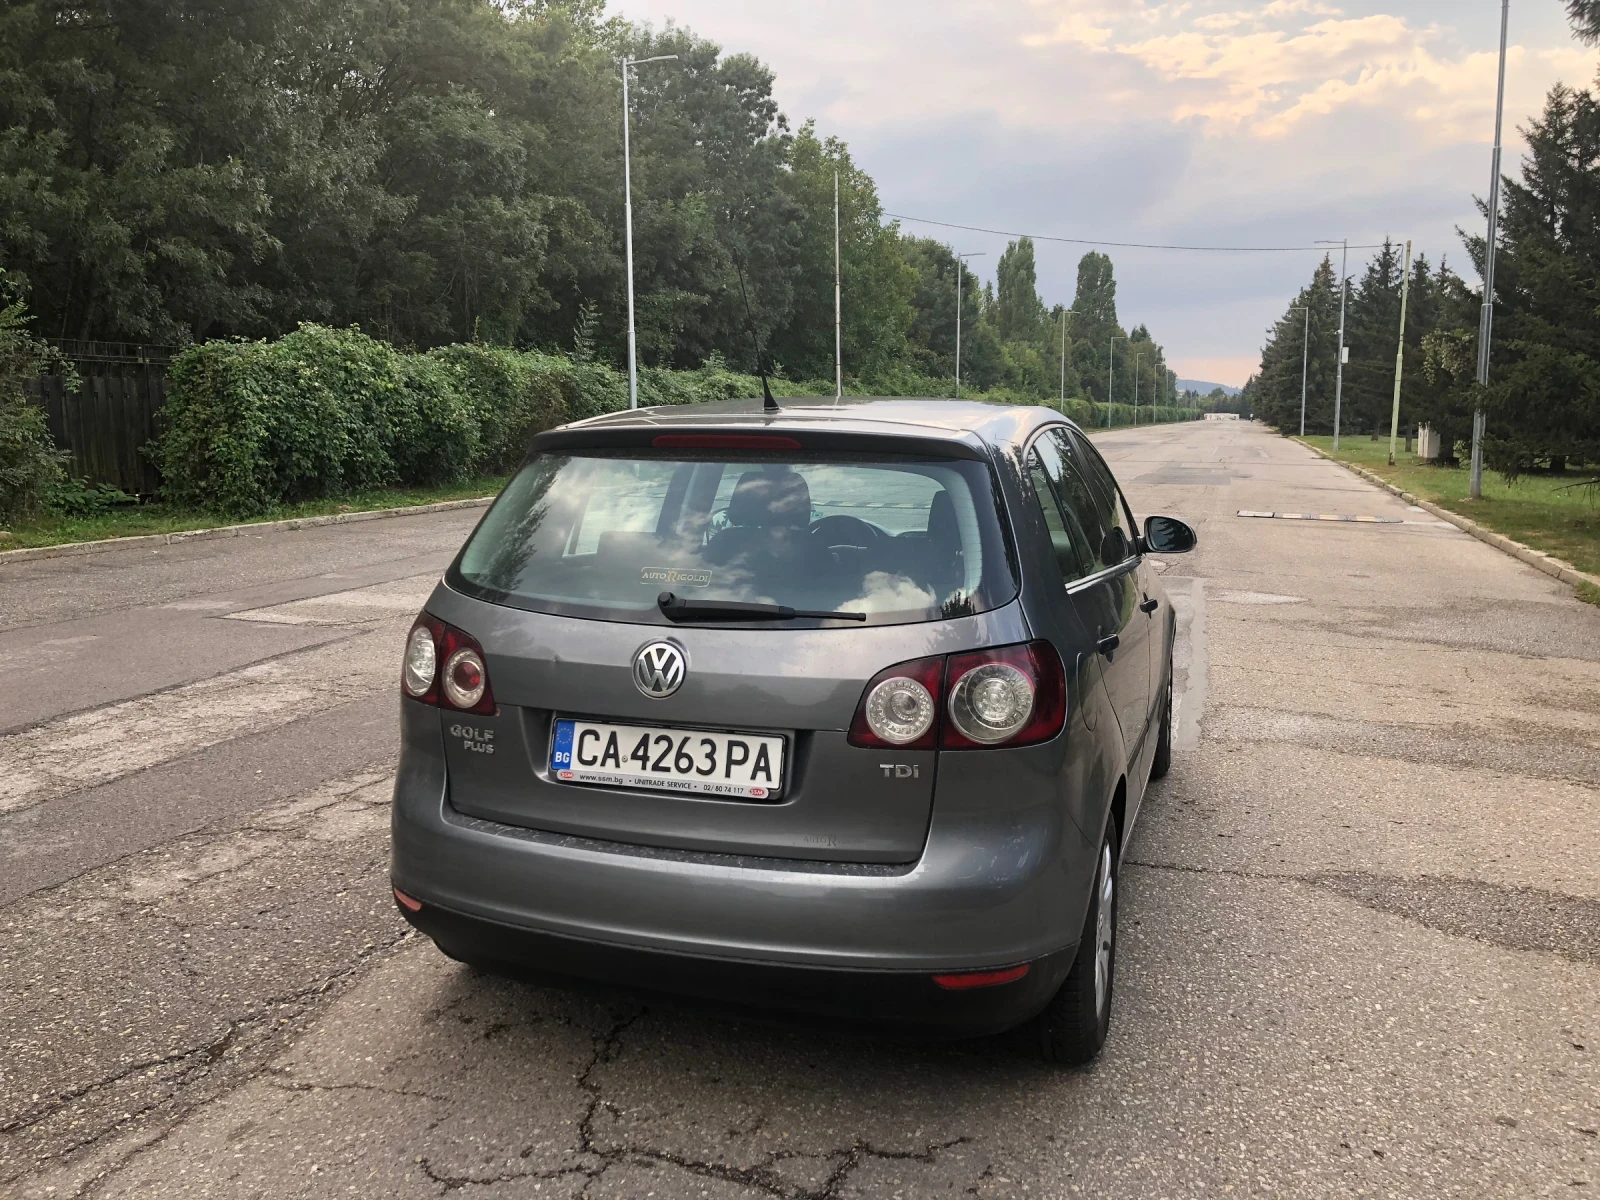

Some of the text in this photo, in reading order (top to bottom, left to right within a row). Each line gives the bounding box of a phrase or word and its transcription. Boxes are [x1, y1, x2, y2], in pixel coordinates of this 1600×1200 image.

[450, 724, 495, 742] GOLF
[463, 740, 495, 754] PLUS
[555, 751, 571, 763] BG
[577, 729, 772, 782] CA 4263 PA
[579, 774, 624, 784] www.ssm.bg
[634, 778, 665, 787] UNITRADE
[666, 780, 692, 789] SERVICE
